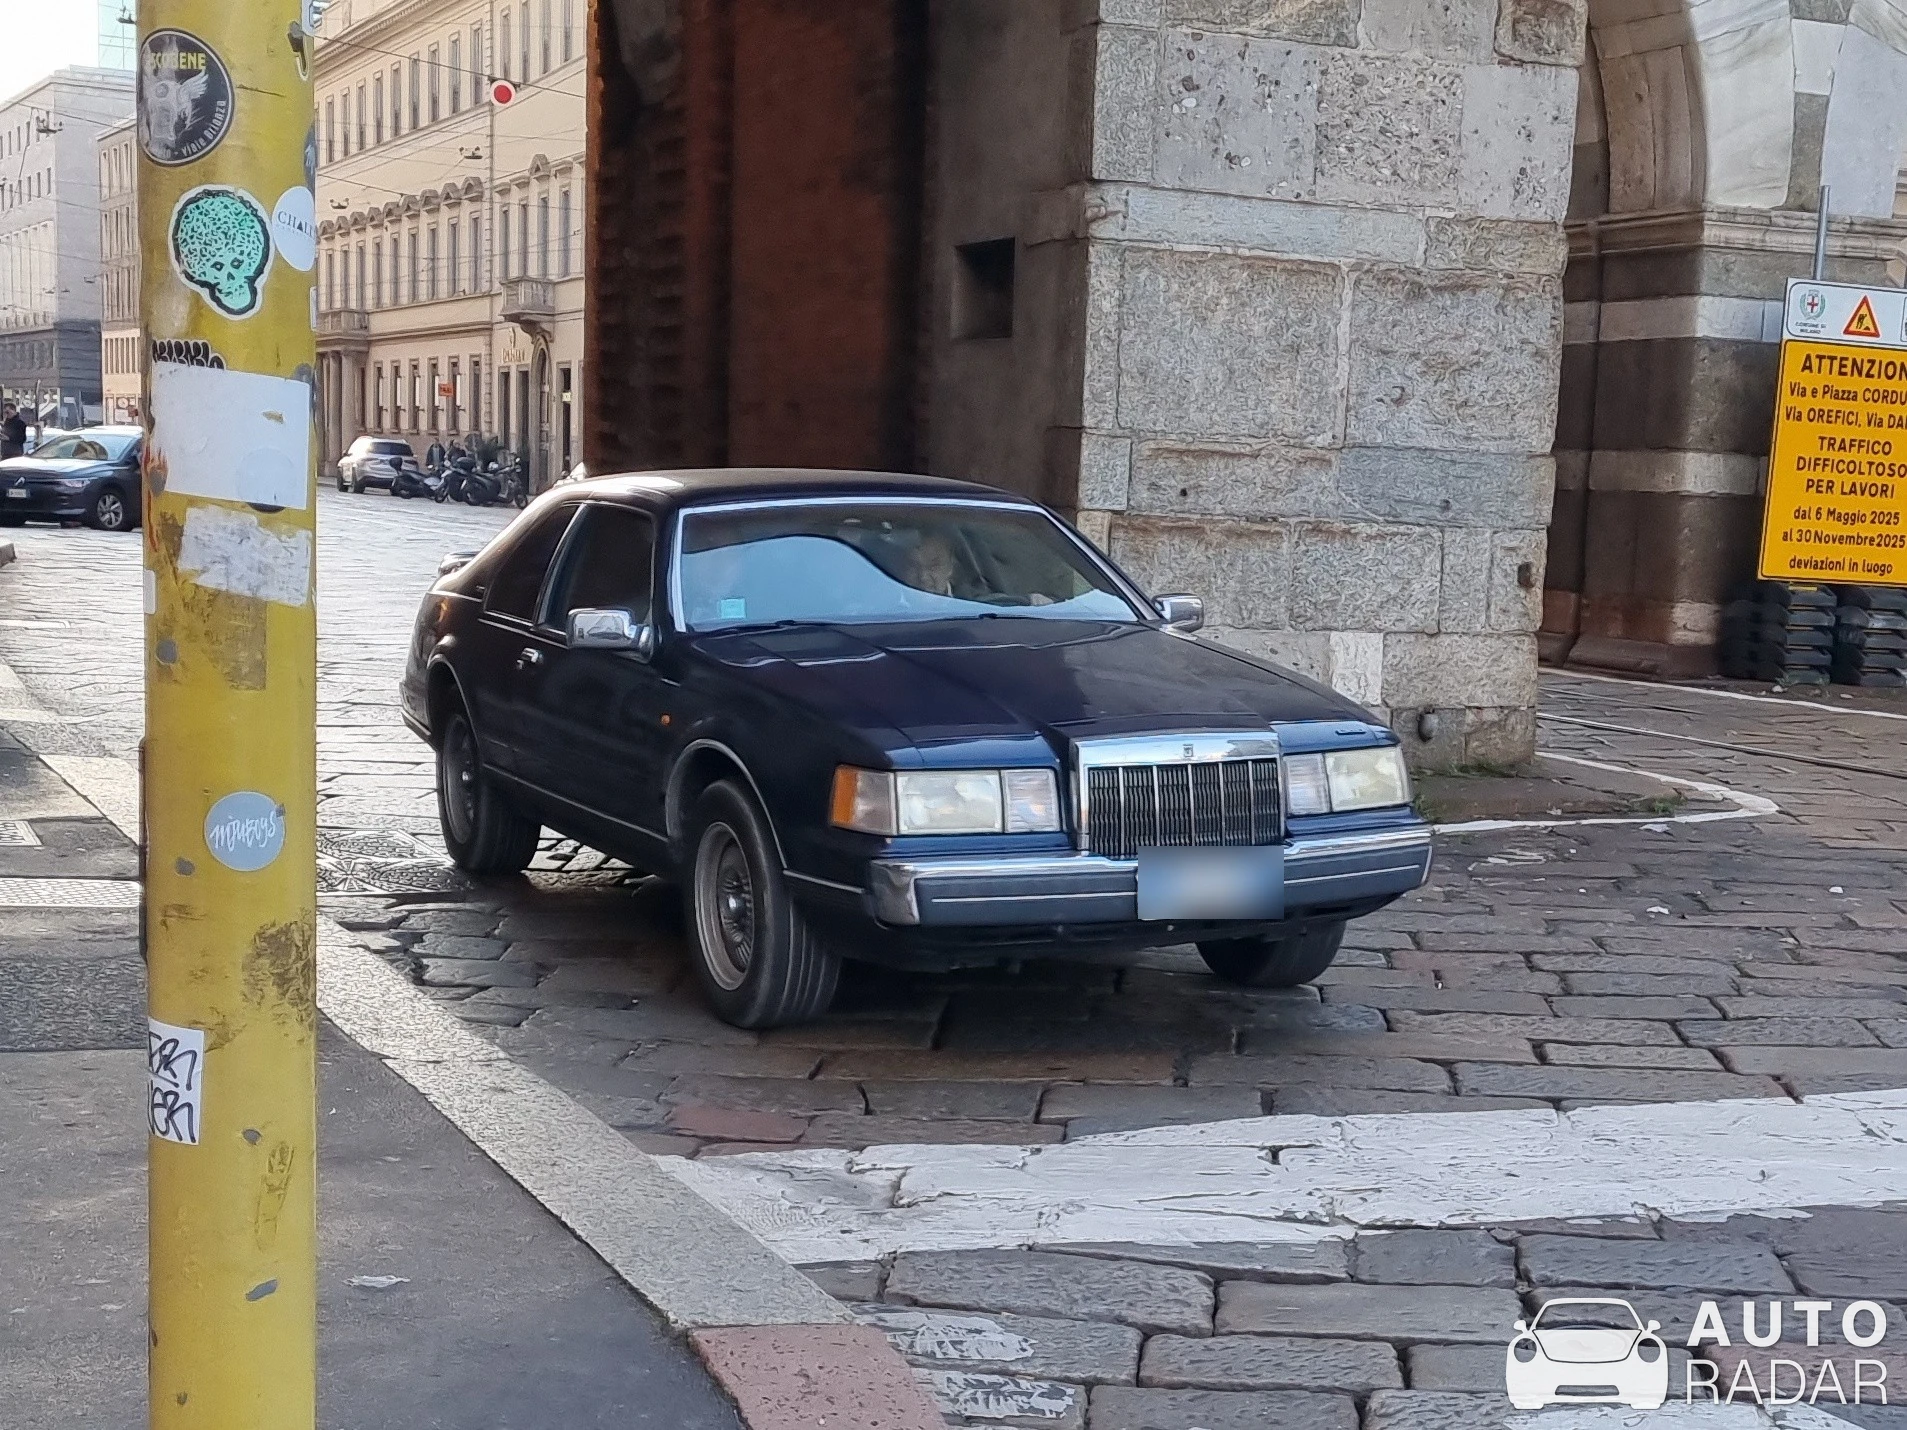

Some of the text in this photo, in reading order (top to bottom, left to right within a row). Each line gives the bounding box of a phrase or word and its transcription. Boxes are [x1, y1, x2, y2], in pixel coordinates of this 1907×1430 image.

[1789, 381, 1807, 397] Via
[1811, 387, 1818, 398] e
[1822, 384, 1858, 402] Piazza
[1785, 405, 1907, 430] Via OREFICI, Via DA
[1818, 435, 1892, 456] TRAFFICO
[1796, 455, 1907, 478] DIFFICOLTOSO
[1805, 478, 1895, 499] PER LAVORI
[1793, 505, 1900, 526] dal 6 Maggio 2025
[1782, 528, 1906, 549] al 30 Novembre 2025
[1789, 555, 1893, 577] deviazioni in luogo
